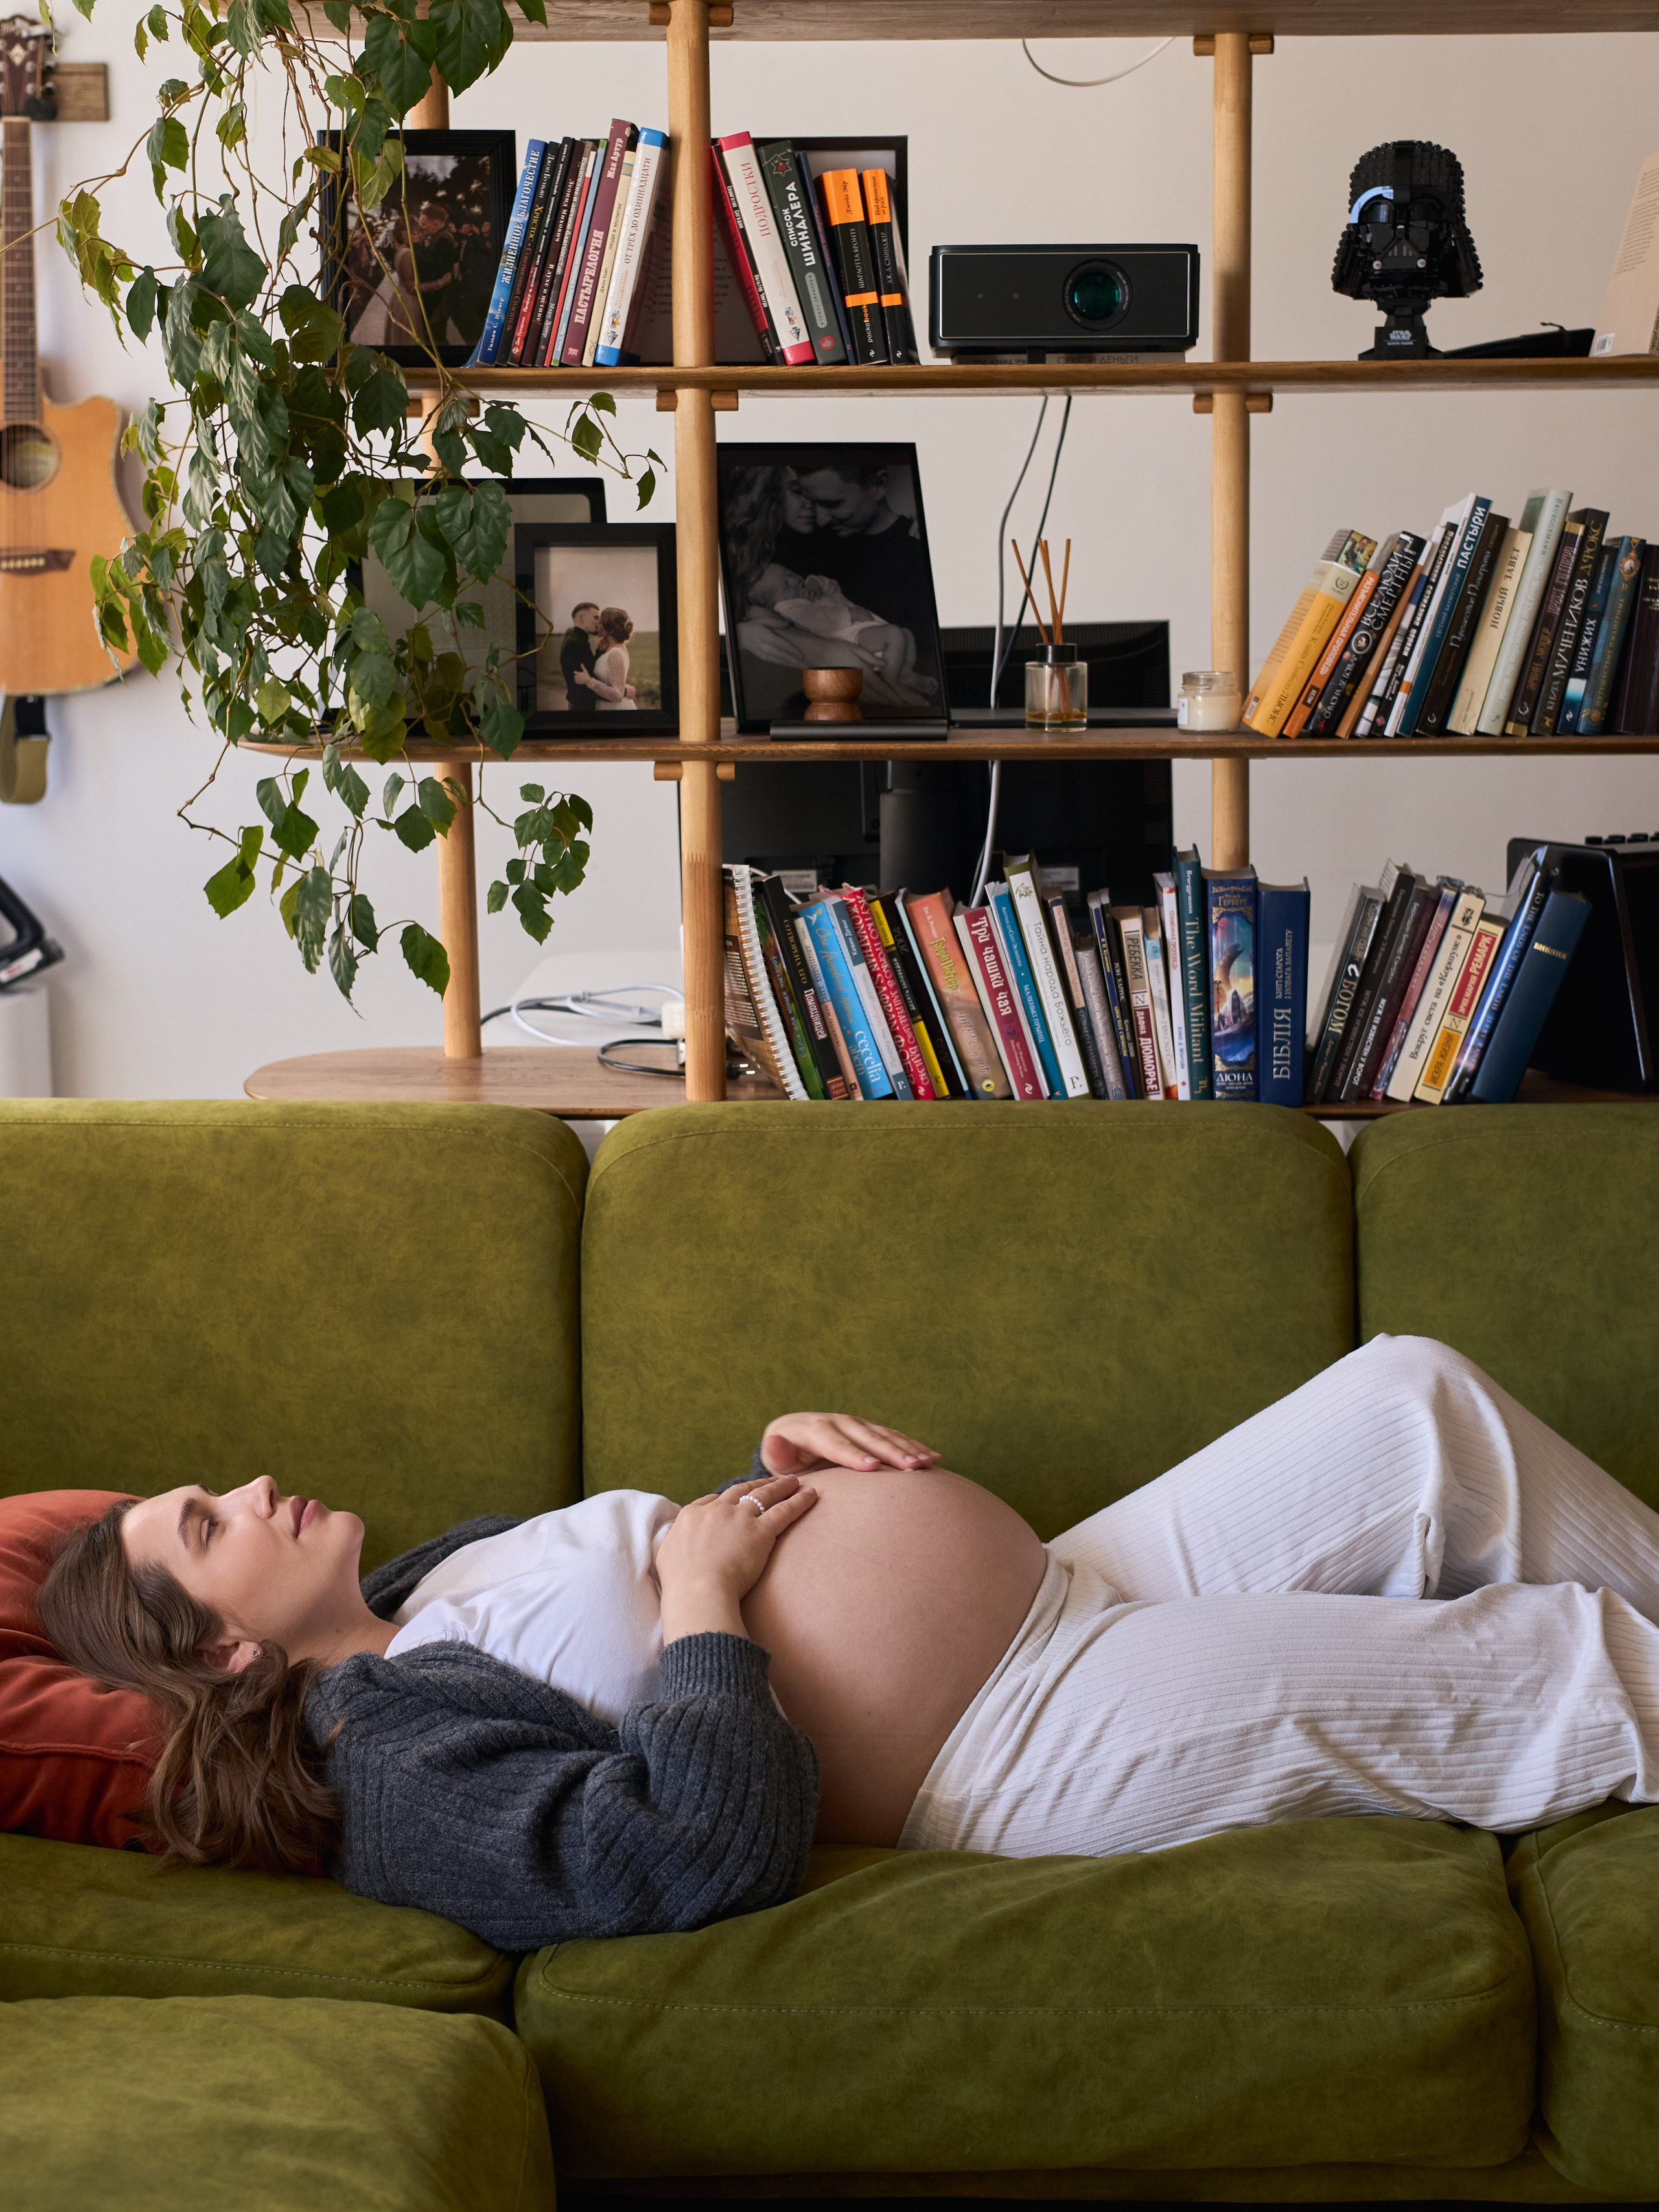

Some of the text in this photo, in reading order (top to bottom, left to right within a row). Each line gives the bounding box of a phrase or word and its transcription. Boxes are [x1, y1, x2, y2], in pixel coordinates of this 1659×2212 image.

[606, 137, 624, 178] Мак Артур
[501, 149, 540, 284] ЖИЗНЕННОЕ БЛАГОЧЕСТИЕ
[625, 231, 636, 251] ТРЁХ
[632, 157, 653, 218] ОДИННАДЦАТИ
[741, 162, 771, 237] ПОДРОСТКИ
[790, 181, 816, 267] ШИНДЛЕРА
[608, 233, 616, 250] ЛЮДИ
[612, 202, 622, 227] МОЛИТВЕ
[782, 207, 799, 247] СПИСОК
[574, 229, 604, 324] ПАСТЫРЕЛОГИЯ
[853, 253, 864, 288] ШАРЛОТТА
[1373, 550, 1404, 596] ЛЮДИ
[1428, 530, 1454, 583] Продуманное
[1338, 576, 1375, 637] РАЗЪЯСНИТЕЛЬНАЯ
[1369, 555, 1415, 632] СМЕРТНЫ
[1487, 546, 1521, 629] НОВЫЙ ЗАВЕТ
[1400, 627, 1418, 657] церкви
[1549, 577, 1590, 679] МУЧЕНИКОВ
[1574, 617, 1596, 673] ХИЖИНА
[1317, 636, 1344, 677] ПРОПОВЕДЬ
[1265, 690, 1290, 725] ЛЬЮИС
[1305, 688, 1317, 704] ХЕЛМ
[1185, 870, 1194, 914] Brueggemann
[781, 918, 804, 966] СОТВОРЕНА
[797, 968, 809, 984] ЕГО
[839, 917, 858, 956] Кевин Деянг
[890, 925, 909, 955] 2004
[1126, 936, 1143, 980] РЕБЕККА
[1284, 929, 1292, 966] ЗАПАВЕТУ
[1468, 934, 1492, 975] РЕМАРК
[855, 893, 879, 940] ЖУТКО
[907, 1045, 930, 1086] БЛИЗКО
[892, 957, 916, 1010] ДЕСЯТЬ ЗАПОВЕДЕЙ
[927, 936, 962, 992] Гарри Поттер
[968, 916, 1013, 1016] Три чашки чая
[1032, 921, 1073, 1046] Тайна народа Божьего
[801, 988, 830, 1040] Помощницей
[1184, 917, 1205, 1064] The Word Militant
[1327, 977, 1357, 1034] БОГОМ
[1375, 997, 1386, 1016] МУЖ
[853, 1027, 886, 1083] cecelia
[882, 1039, 898, 1067] Почему
[1271, 1007, 1292, 1080] БІБЛІЯ
[1361, 1024, 1377, 1056] ИЗВЕСТЕН
[1409, 1027, 1428, 1060] Вокруг
[1422, 1001, 1437, 1026] света
[848, 1043, 867, 1075] ahern
[1137, 1036, 1157, 1091] ДЮМОРЬЕ
[1216, 1073, 1253, 1082] ДЮНА
[1351, 1062, 1364, 1086] ВОРОТ
[1428, 1032, 1454, 1084] ИСКРА ЖИЗНИ
